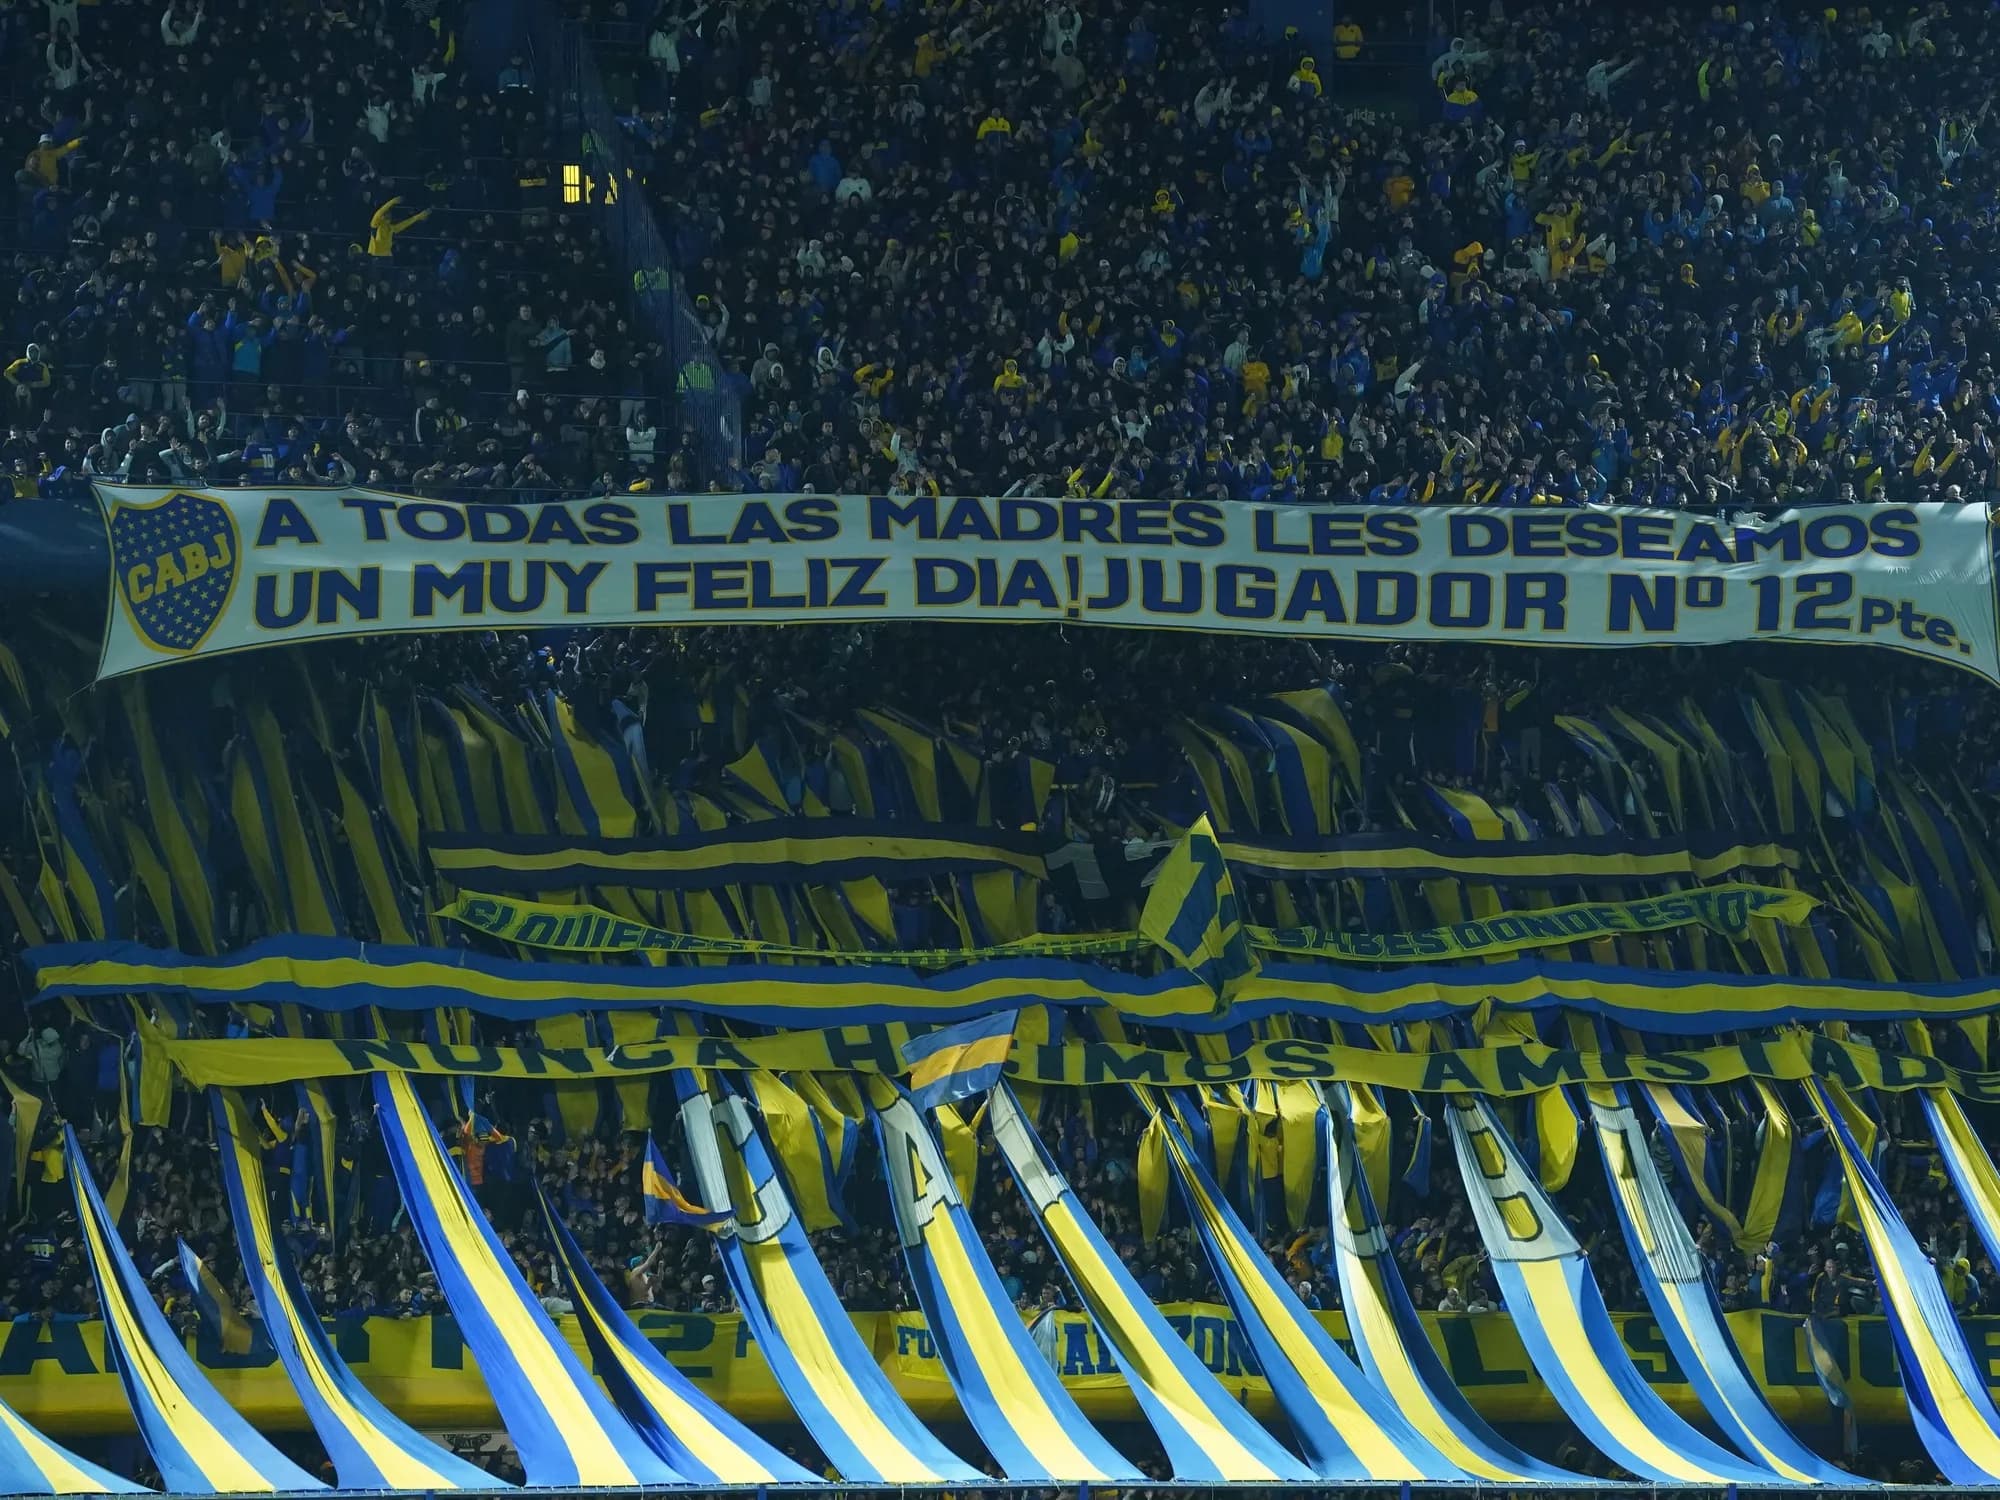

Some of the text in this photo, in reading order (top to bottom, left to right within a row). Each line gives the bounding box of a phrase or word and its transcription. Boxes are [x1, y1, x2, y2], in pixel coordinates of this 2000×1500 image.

[254, 495, 1922, 563] A TODAS LAS MADRES LES DESEAMOS
[127, 532, 231, 604] CABJ
[255, 565, 382, 631] UN
[410, 560, 609, 617] MUY
[634, 556, 891, 613] FELIZ
[1750, 572, 1854, 633] 12
[1859, 598, 1973, 656] Pte.
[1450, 905, 1627, 950] DONDE
